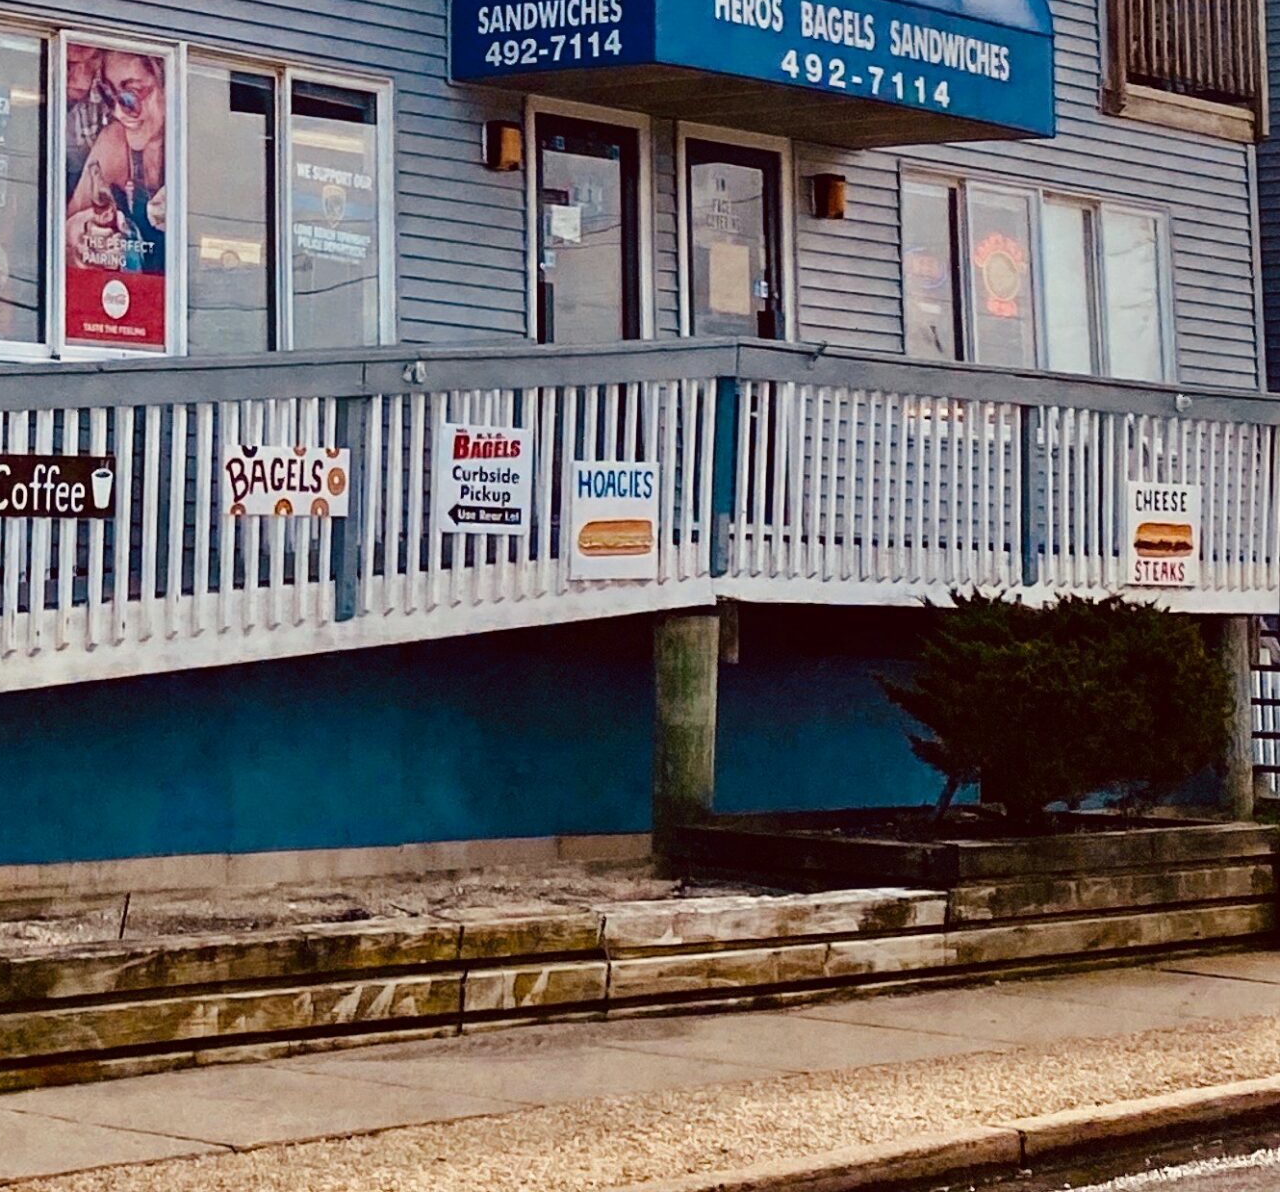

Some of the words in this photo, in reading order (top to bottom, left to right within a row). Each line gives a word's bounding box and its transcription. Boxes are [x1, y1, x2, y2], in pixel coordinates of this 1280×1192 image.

[485, 29, 622, 67] 492-7114
[800, 0, 876, 52] BAGELS
[889, 20, 1010, 83] SANDWICHES
[781, 49, 952, 108] 492-7114
[312, 165, 353, 186] SUPPORT
[353, 174, 372, 191] OUR
[82, 235, 104, 248] THE
[107, 236, 155, 254] PERFECT
[82, 251, 127, 267] PAIRING
[453, 435, 521, 460] BAGELS
[226, 457, 324, 502] BAGELS
[452, 465, 520, 484] Curbside
[577, 469, 653, 500] HOAGIES
[460, 484, 511, 506] Pickup
[1135, 489, 1188, 512] CHEESE
[457, 509, 476, 521] Use
[479, 509, 502, 521] Rear
[505, 510, 519, 522] Lot
[1134, 560, 1185, 582] STEAKS
